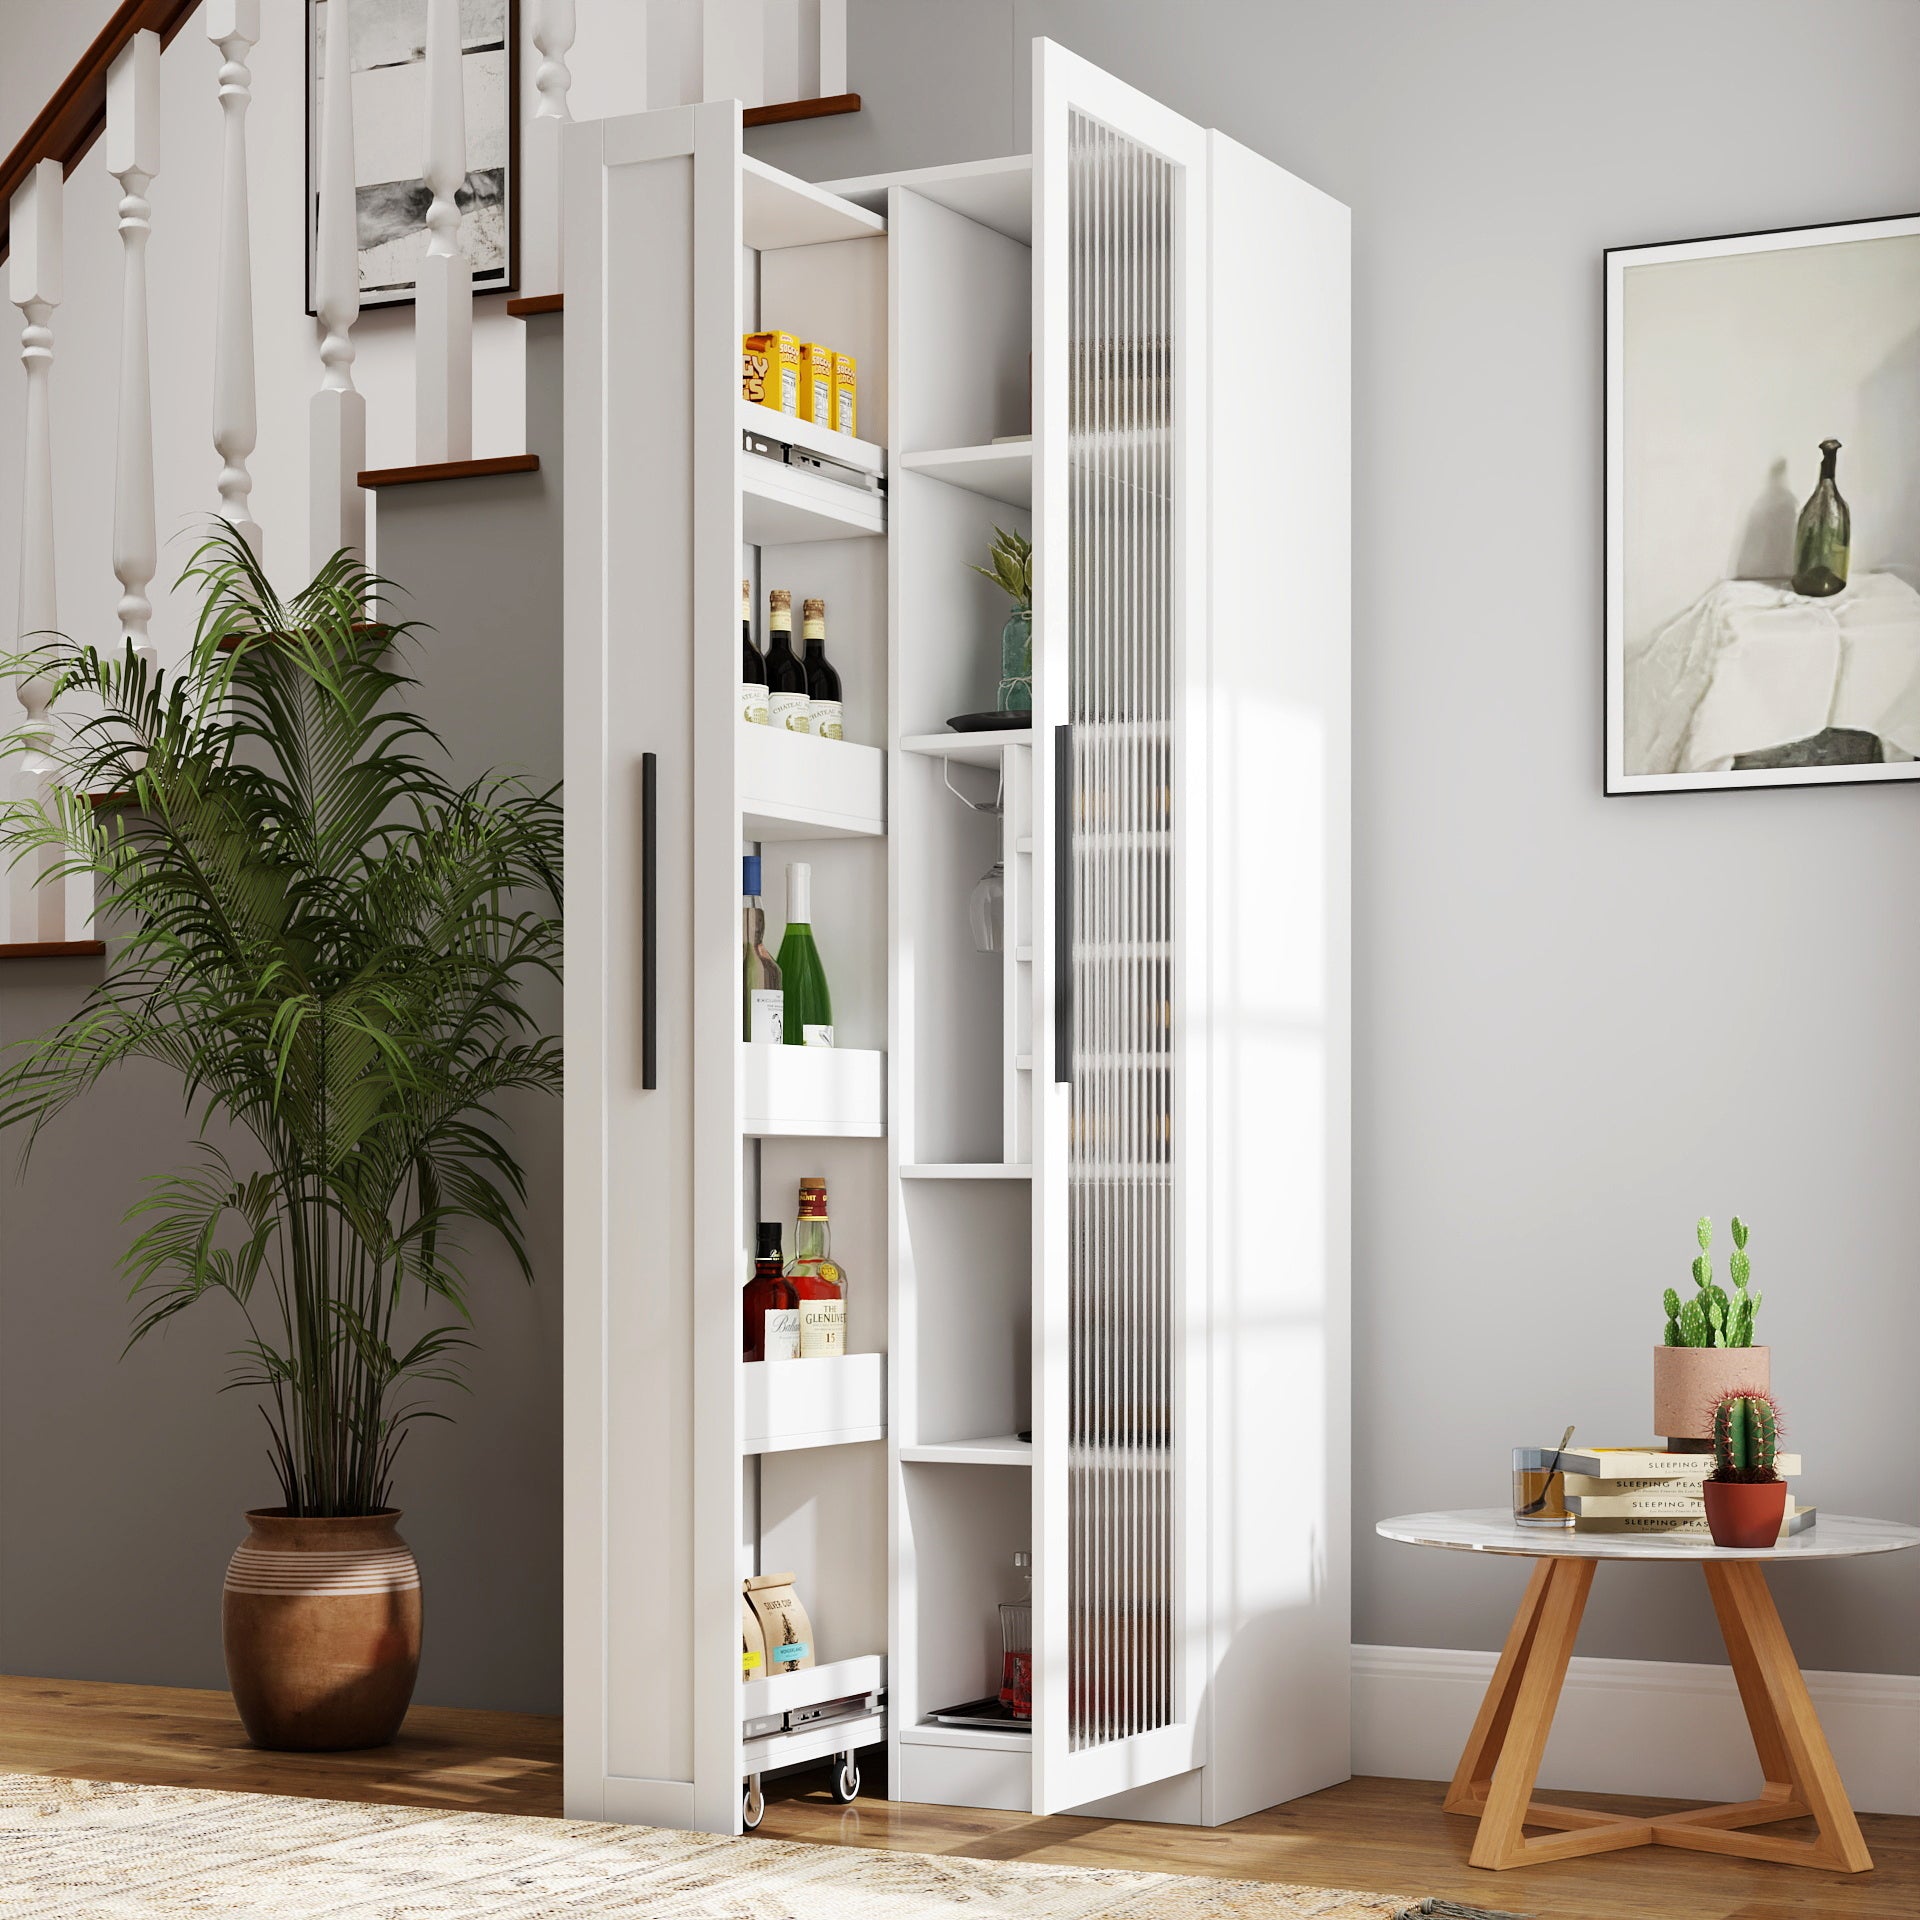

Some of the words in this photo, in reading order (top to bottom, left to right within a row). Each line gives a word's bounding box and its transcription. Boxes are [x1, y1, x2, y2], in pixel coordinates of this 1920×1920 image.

[824, 1305, 837, 1313] THE
[805, 1312, 847, 1325] GLENLIVET
[826, 1332, 836, 1343] 15
[763, 1600, 781, 1610] SILVER
[781, 1599, 792, 1608] CUP
